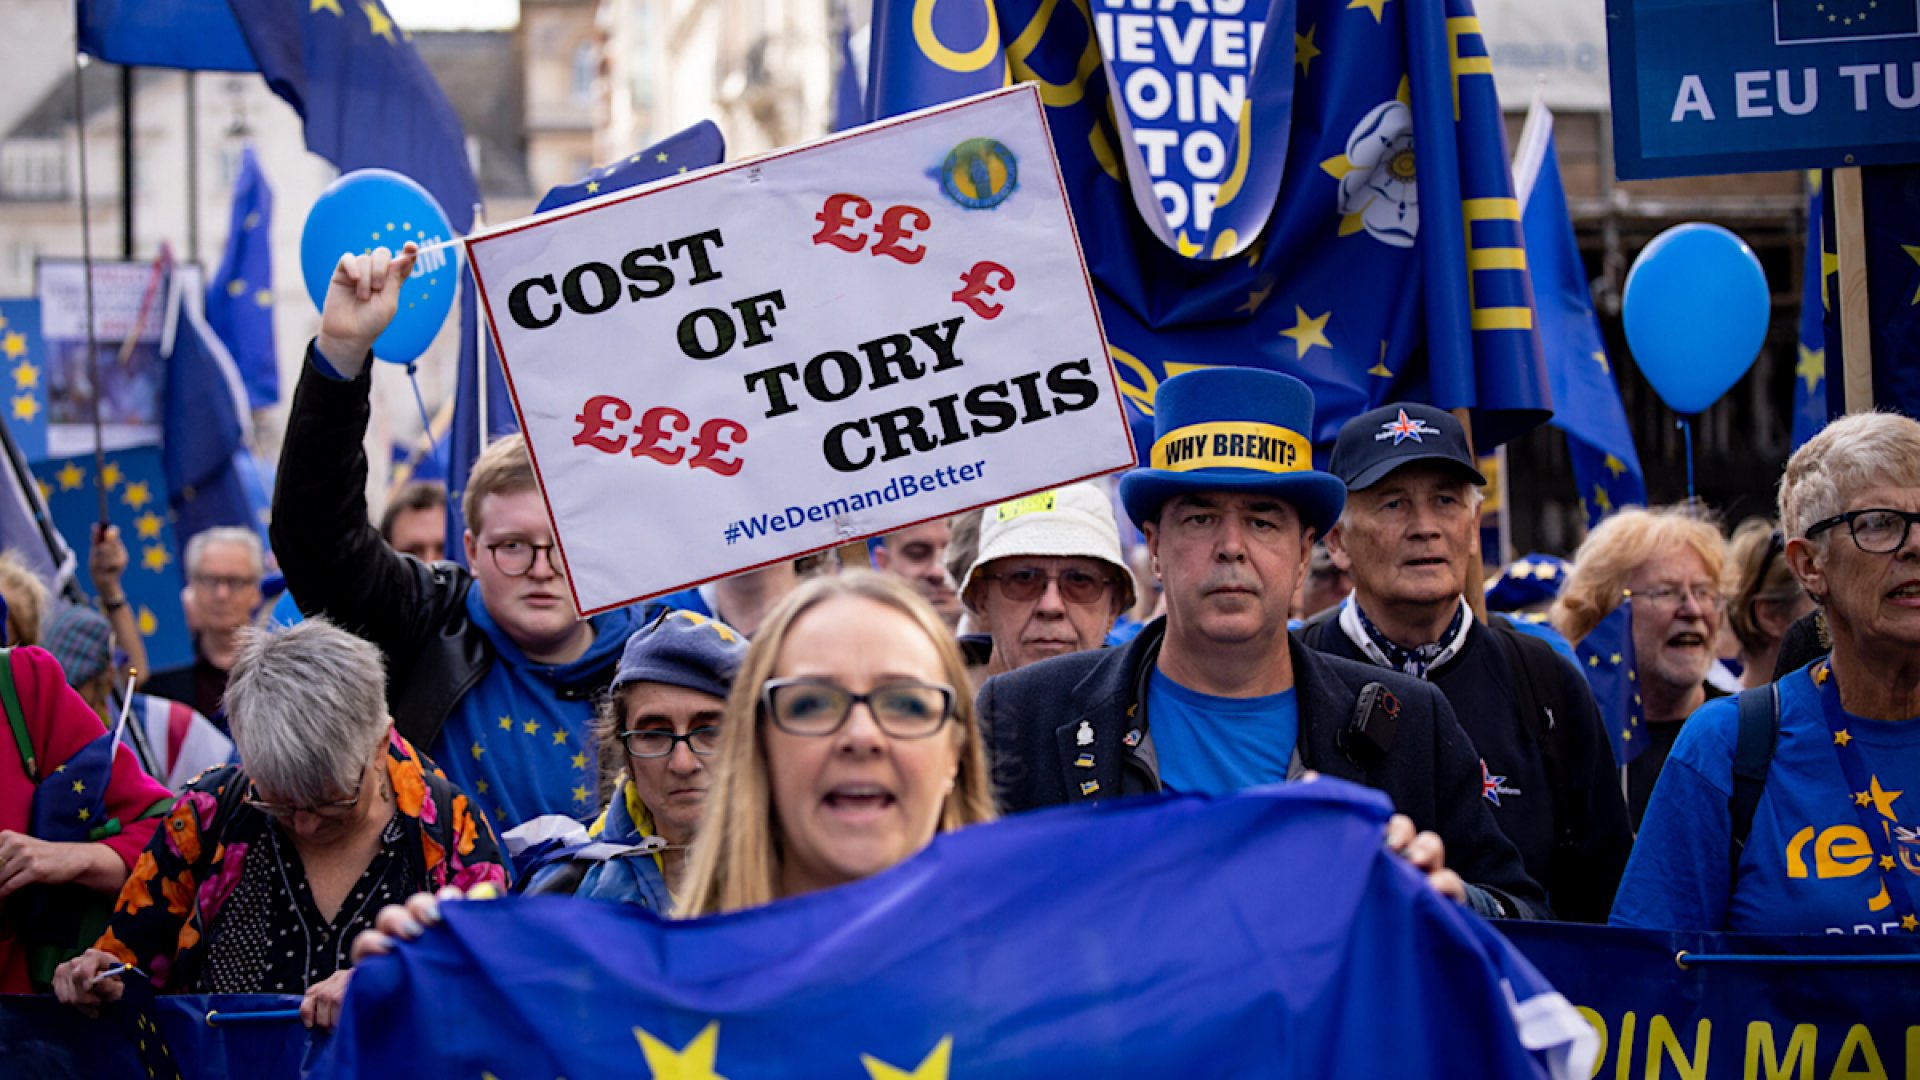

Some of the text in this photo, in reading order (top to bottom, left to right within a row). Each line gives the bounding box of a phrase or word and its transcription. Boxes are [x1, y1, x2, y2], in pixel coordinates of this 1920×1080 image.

[1670, 61, 1920, 122] A EU TU
[1133, 127, 1226, 179] TO
[507, 228, 725, 330] COST
[952, 260, 1016, 320] £
[676, 289, 787, 361] OF
[743, 316, 965, 419] TORY
[822, 357, 1100, 473] CRISIS
[1165, 433, 1297, 467] WHY BREXIT?
[724, 459, 988, 546] #WeDemandBetter
